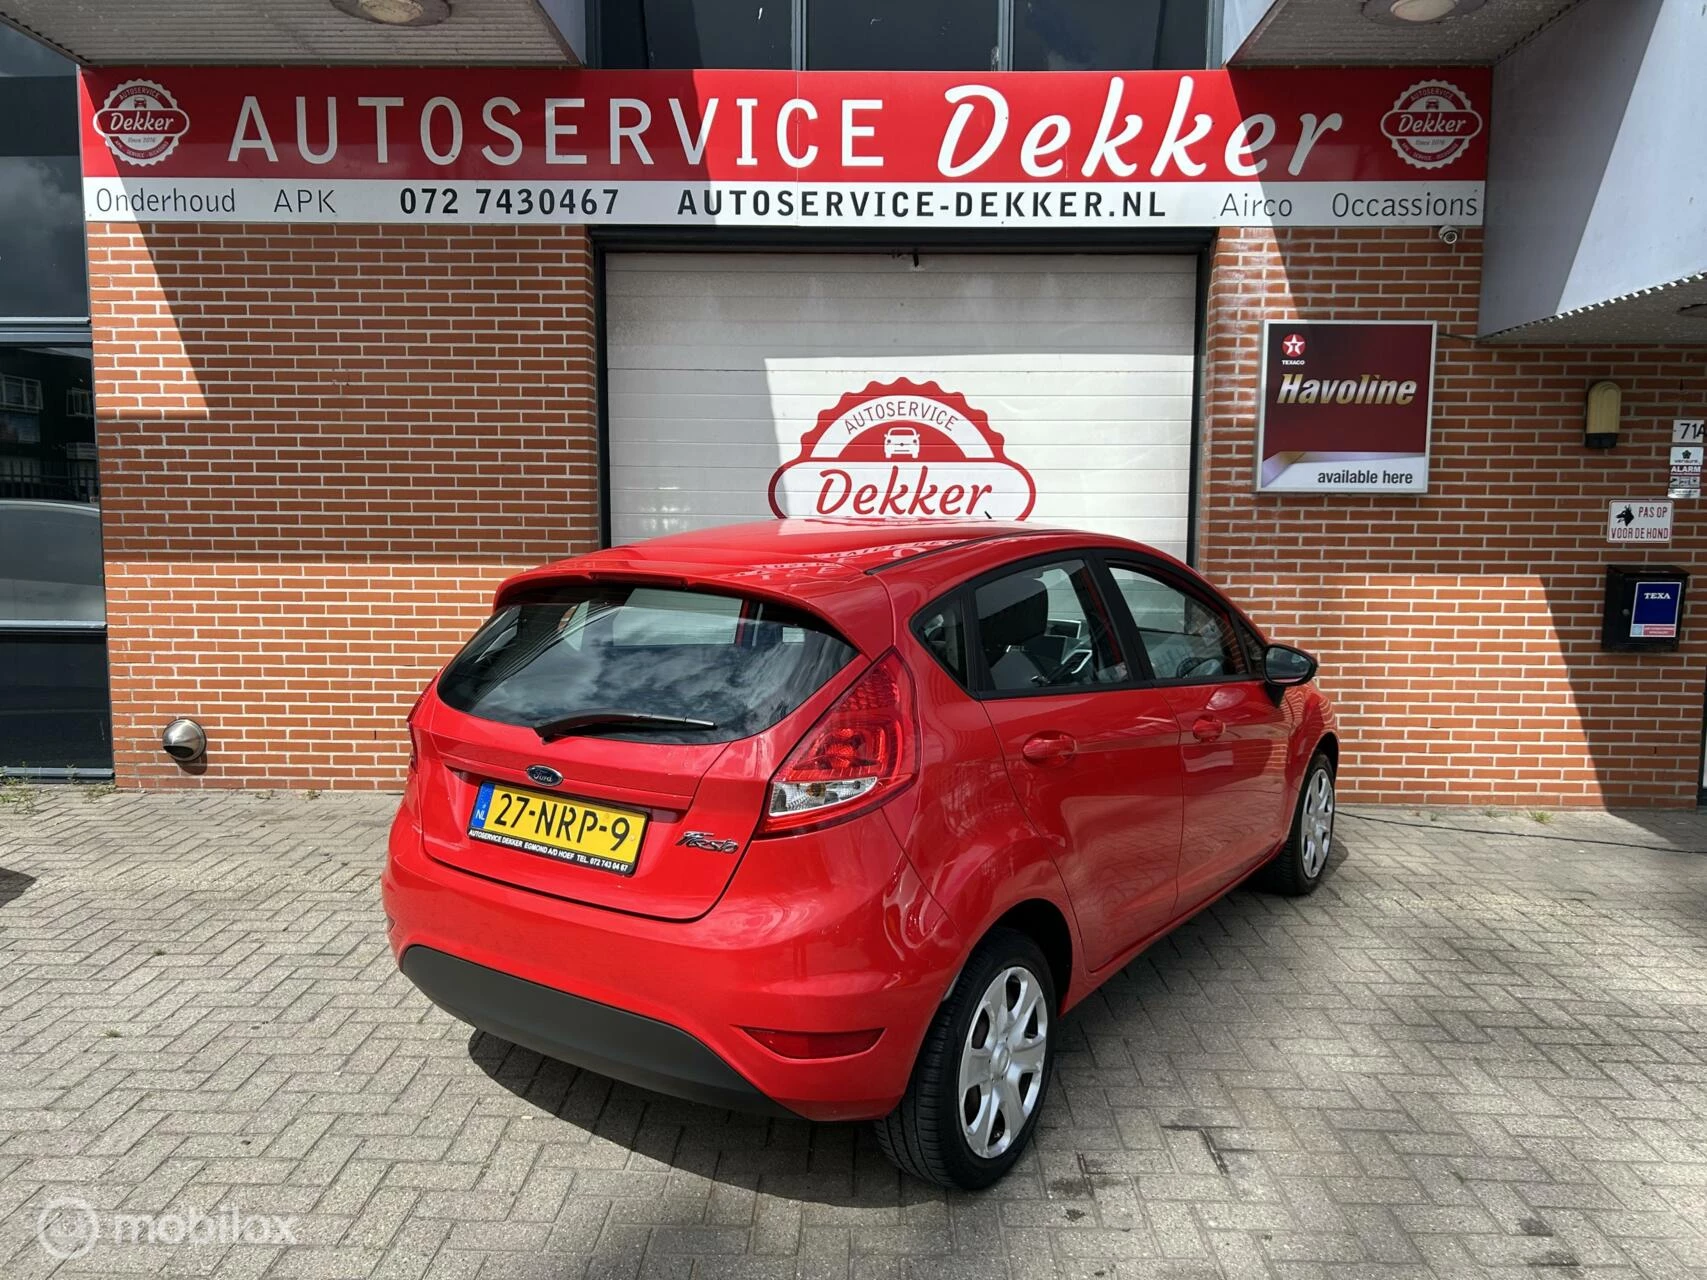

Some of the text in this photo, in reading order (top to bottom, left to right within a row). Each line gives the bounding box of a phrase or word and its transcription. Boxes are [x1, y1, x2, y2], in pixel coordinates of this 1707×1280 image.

[119, 86, 161, 100] AUTOSERVICE
[1410, 87, 1454, 101] AUTOSERVICE
[110, 111, 174, 131] Dekker
[227, 76, 1343, 178] AUTOSERVICE Dekker
[1398, 112, 1467, 133] Dekker
[96, 187, 1478, 218] Onderhoud APK 072 7430467 AUTOSERVICE-DEKKER.NL Airco Occassions
[1276, 373, 1417, 405] Havoline
[844, 400, 959, 435] AUTOSERVICE
[1318, 469, 1413, 484] available here
[816, 465, 993, 515] Dekker
[1638, 506, 1668, 518] PAS OP
[1611, 527, 1669, 539] VOOR DE HOND
[1644, 592, 1671, 600] TEXA
[475, 808, 485, 821] NL
[494, 793, 630, 852] 27-NRP-9
[468, 830, 502, 843] AUTOSERVICE
[502, 836, 524, 848] DEKKER
[524, 842, 548, 854] EGMOND
[558, 849, 575, 860] HOEF
[576, 854, 590, 864] TEL.
[589, 857, 601, 867] 072
